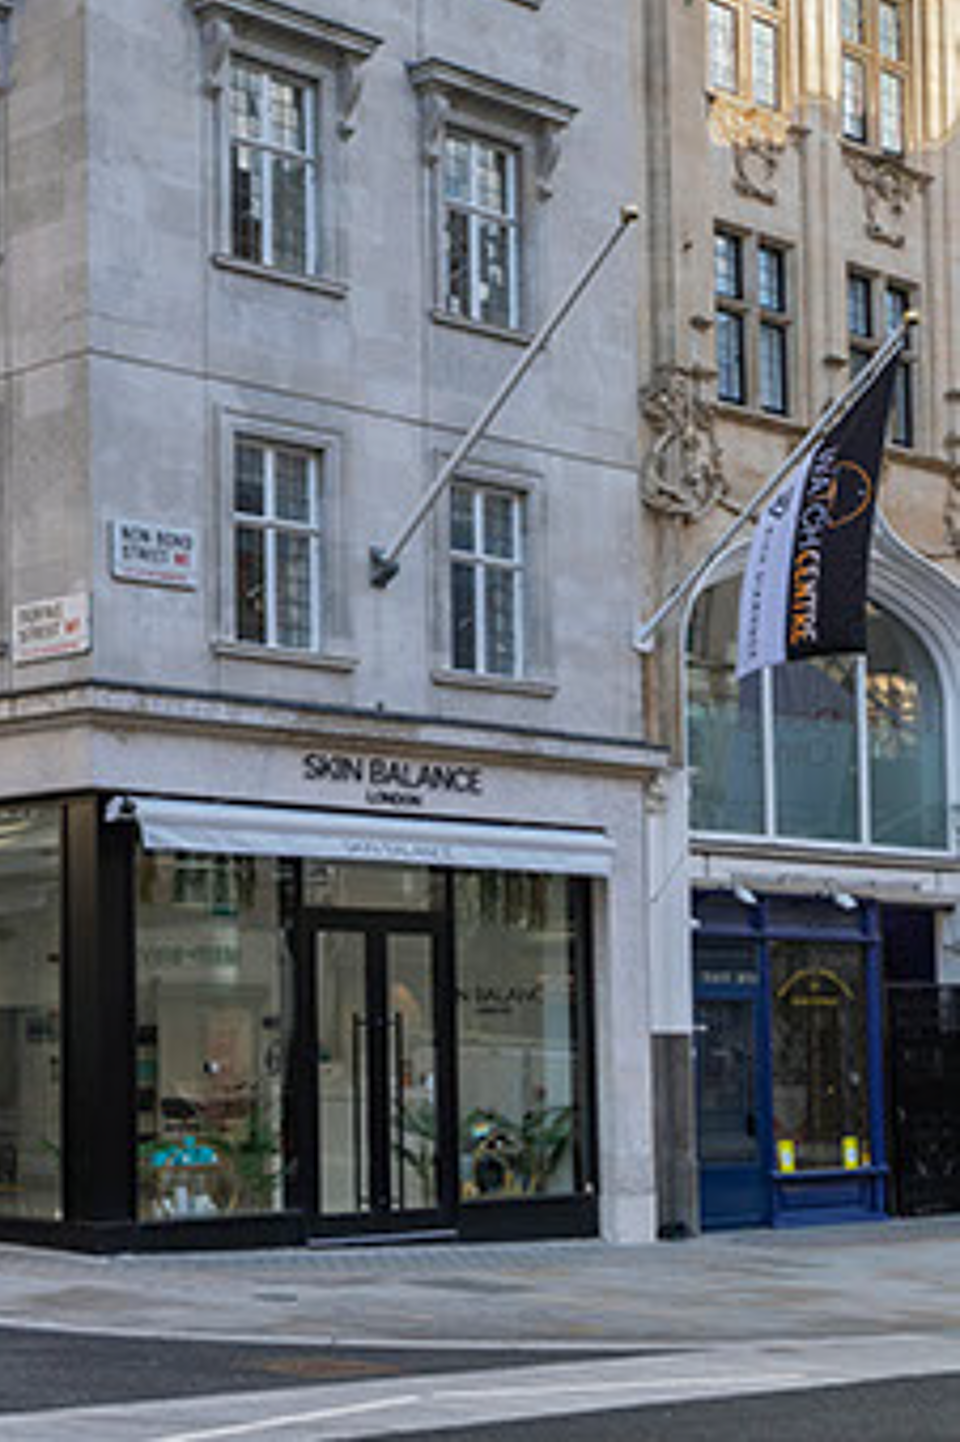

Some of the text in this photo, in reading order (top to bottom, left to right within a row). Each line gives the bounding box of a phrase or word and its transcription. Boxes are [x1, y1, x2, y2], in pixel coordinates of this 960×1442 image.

[304, 753, 482, 796] SKIN BALANCE
[365, 789, 422, 806] LONDON
